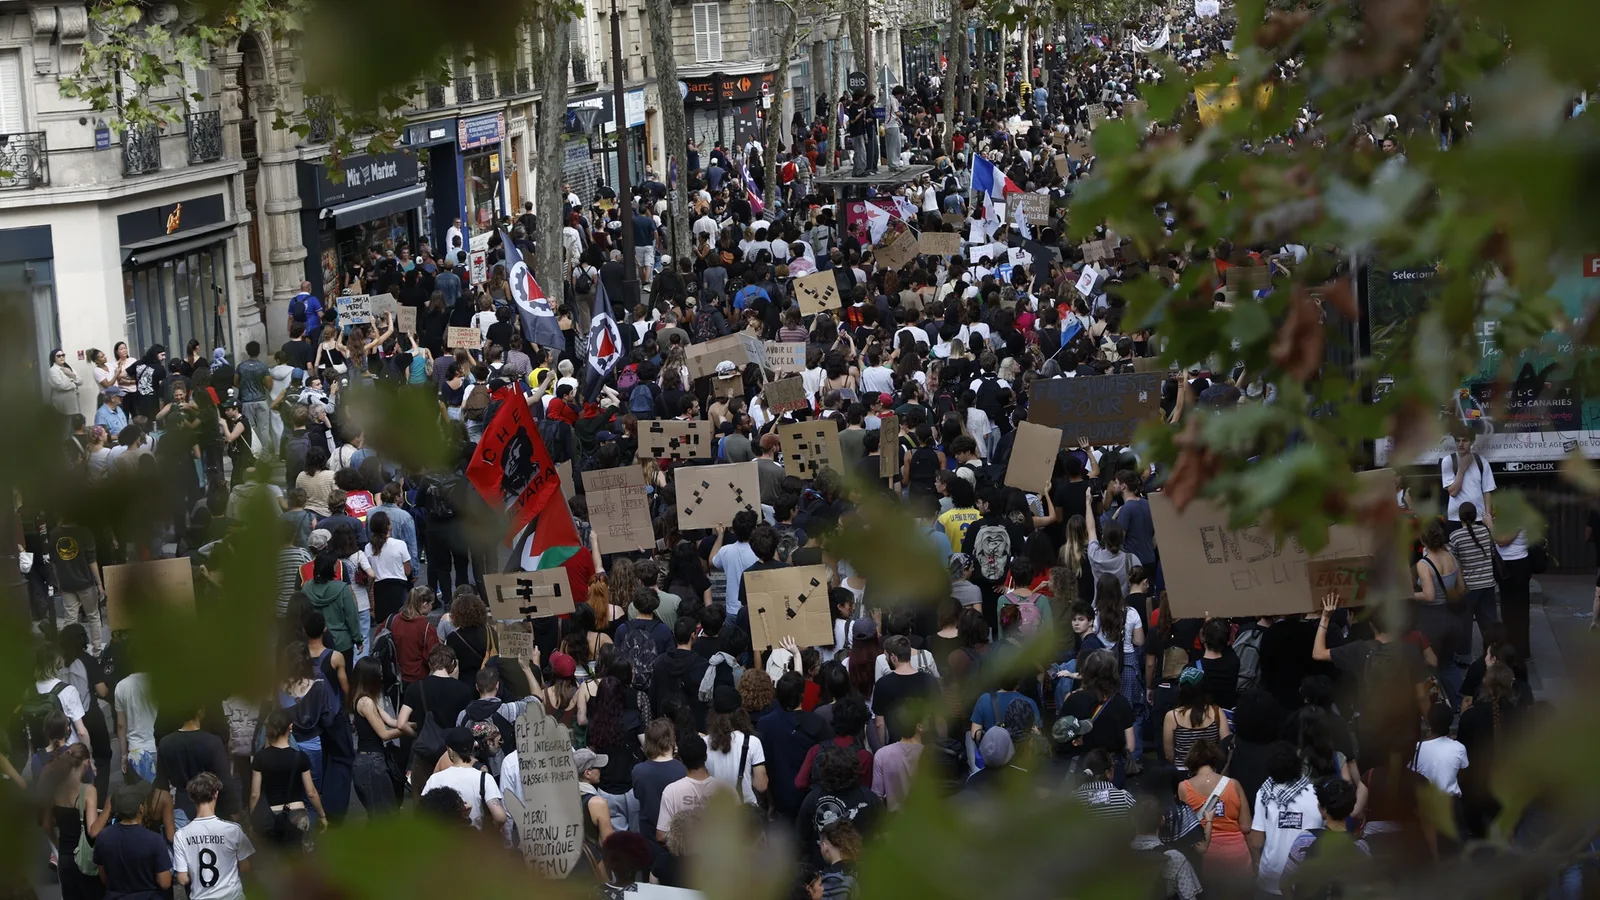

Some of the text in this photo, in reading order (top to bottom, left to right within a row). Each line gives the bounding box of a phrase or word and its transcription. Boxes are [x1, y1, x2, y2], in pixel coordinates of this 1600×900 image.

[346, 161, 398, 188] Mix Market
[1393, 271, 1435, 281] Selectour
[786, 357, 795, 365] LA
[1060, 396, 1122, 416] POUR
[482, 407, 521, 465] CHE
[1502, 462, 1554, 471] JDecaux
[516, 720, 546, 739] PLF 27
[533, 736, 571, 754] INTÉGRALE
[538, 757, 546, 769] DE
[548, 755, 571, 768] TUER
[523, 804, 548, 825] MERCI
[186, 835, 225, 846] VALVERDE
[523, 824, 579, 841] LECORNU ET
[199, 848, 219, 888] 8
[530, 858, 568, 877] TEMU
